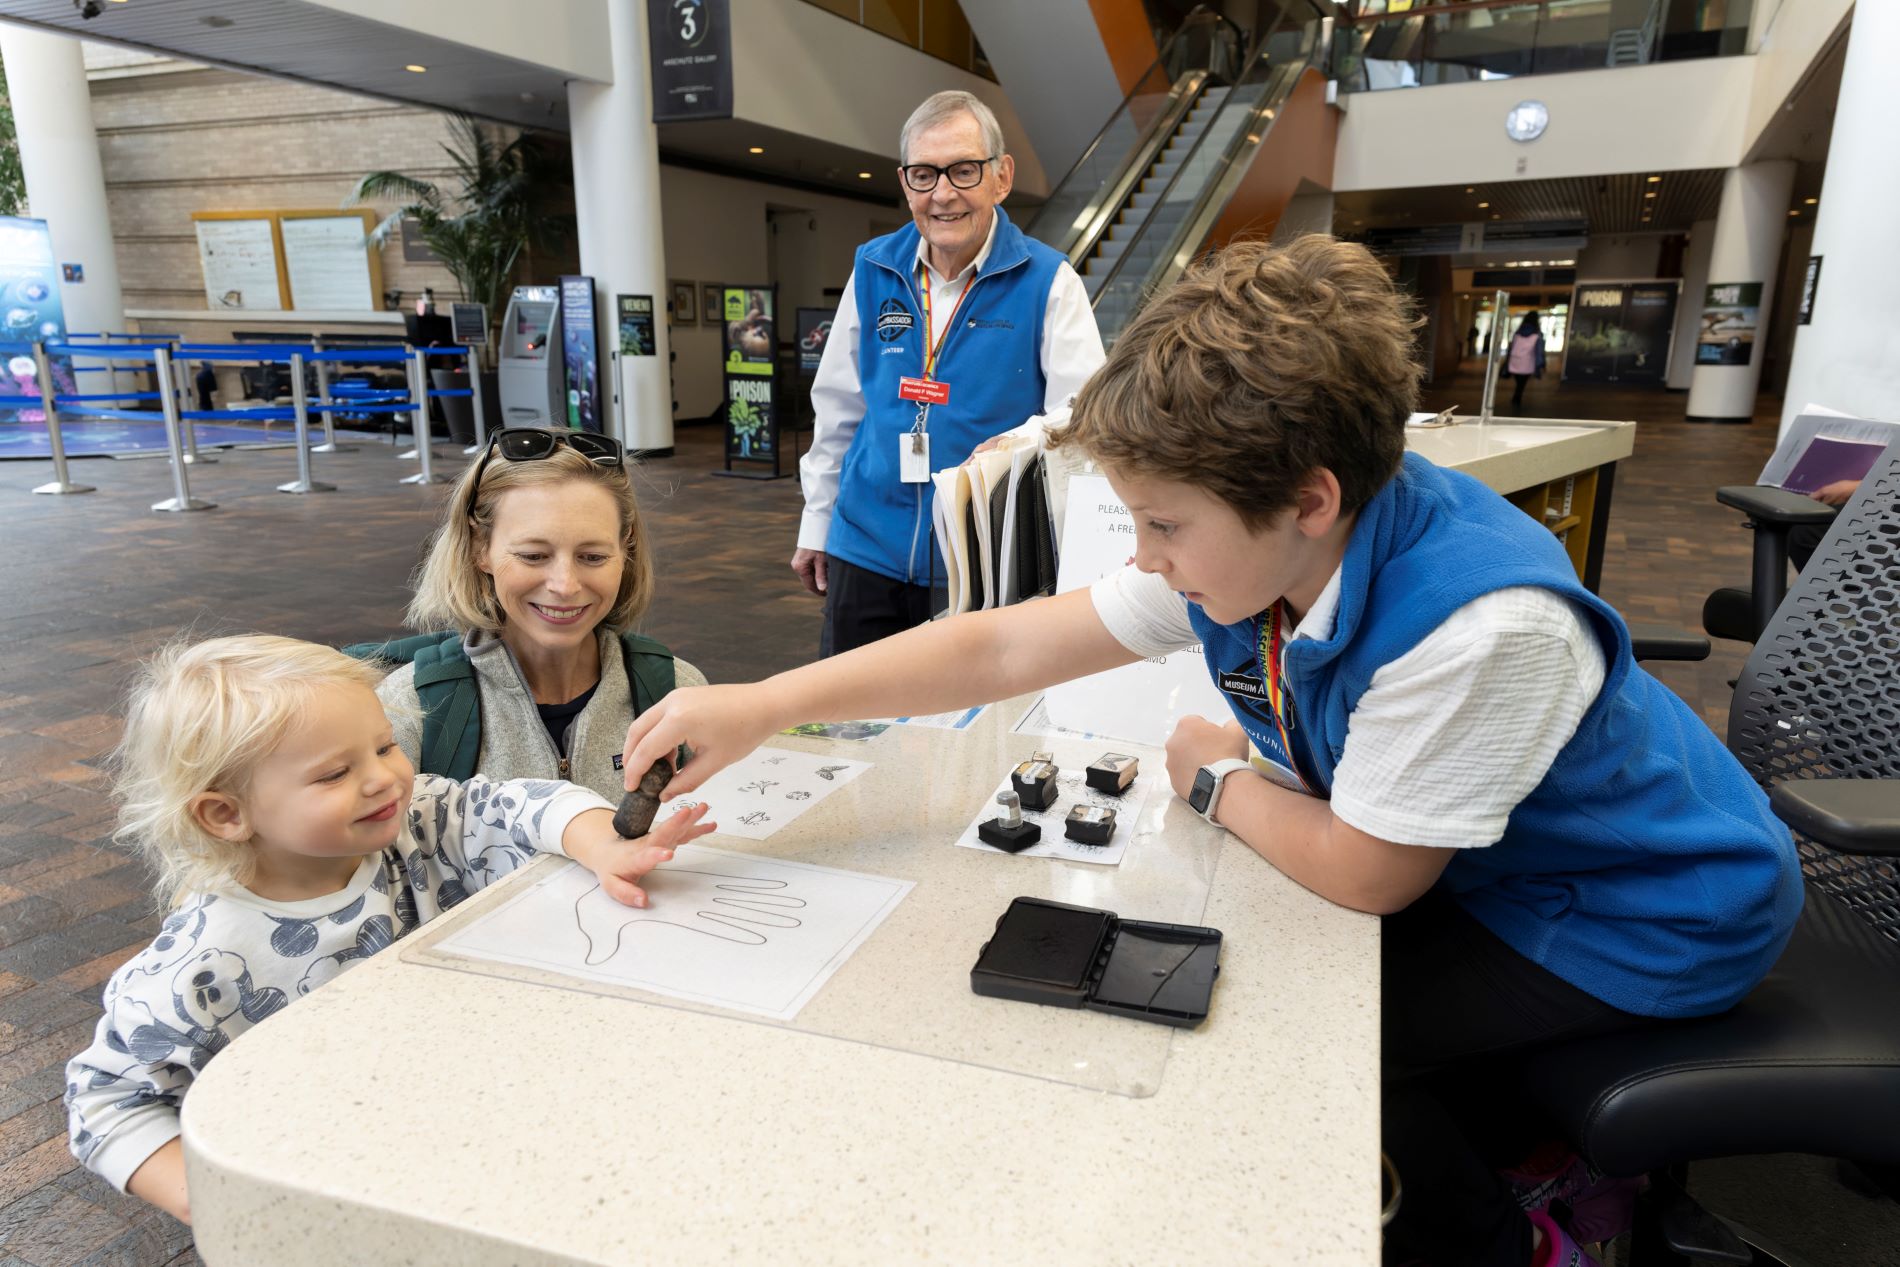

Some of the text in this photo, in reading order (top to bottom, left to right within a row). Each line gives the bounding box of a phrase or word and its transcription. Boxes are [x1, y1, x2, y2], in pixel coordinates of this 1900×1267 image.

[681, 7, 696, 40] 3
[733, 380, 771, 403] POISON
[1109, 523, 1115, 533] A
[1224, 679, 1257, 694] MUSEUM
